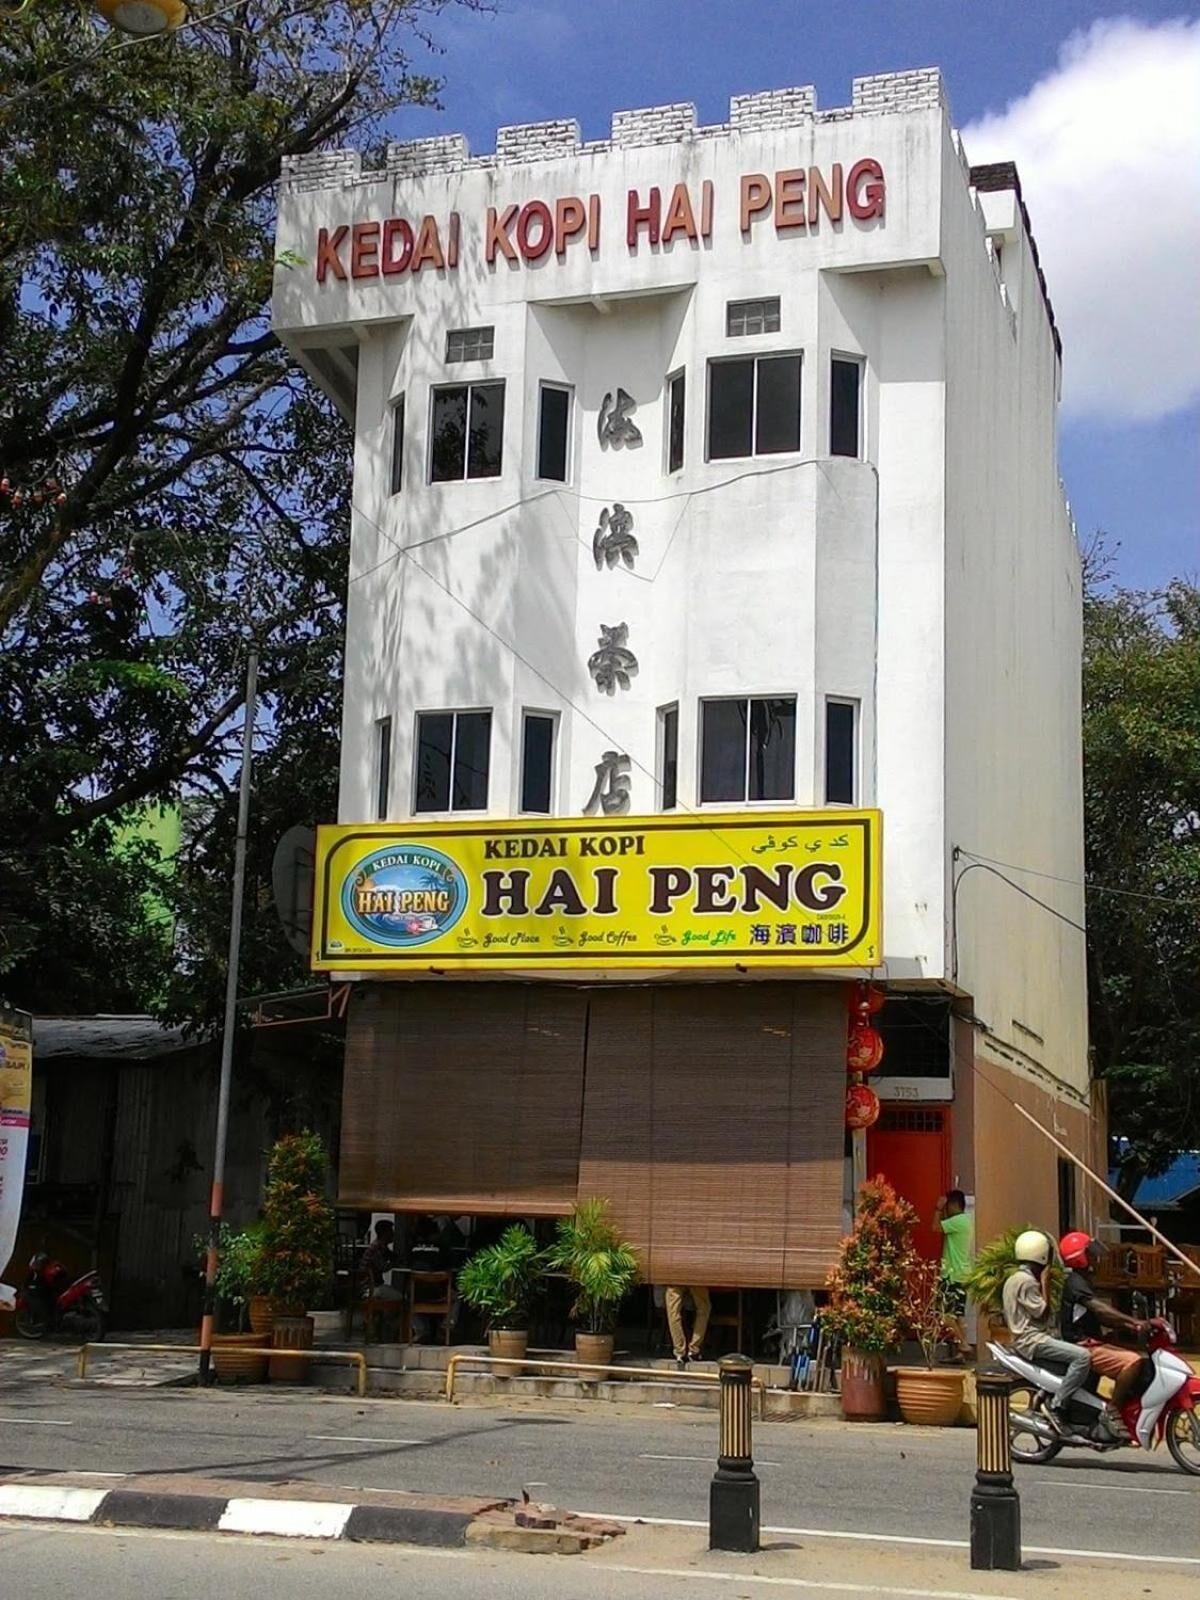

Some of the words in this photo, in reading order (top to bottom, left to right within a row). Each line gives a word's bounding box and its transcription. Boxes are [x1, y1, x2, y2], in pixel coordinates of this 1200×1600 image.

[315, 212, 460, 283] KEDAI
[485, 195, 601, 264] KOPI
[626, 179, 715, 248] HAI
[739, 158, 887, 233] PENG
[484, 837, 569, 859] KEDAI
[579, 835, 646, 857] KOPI
[372, 855, 408, 872] KEDAI
[413, 855, 441, 872] KOPI
[480, 867, 619, 916] HAI
[648, 863, 847, 914] PENG
[357, 890, 394, 914] HAI
[400, 889, 450, 913] PENG
[483, 932, 509, 948] Good
[510, 931, 540, 946] Place
[579, 931, 604, 947] Good
[605, 929, 638, 947] Coffee
[681, 930, 709, 946] Good
[710, 929, 737, 946] Life
[749, 923, 849, 945] 海濱咖啡
[894, 1086, 919, 1098] 3753
